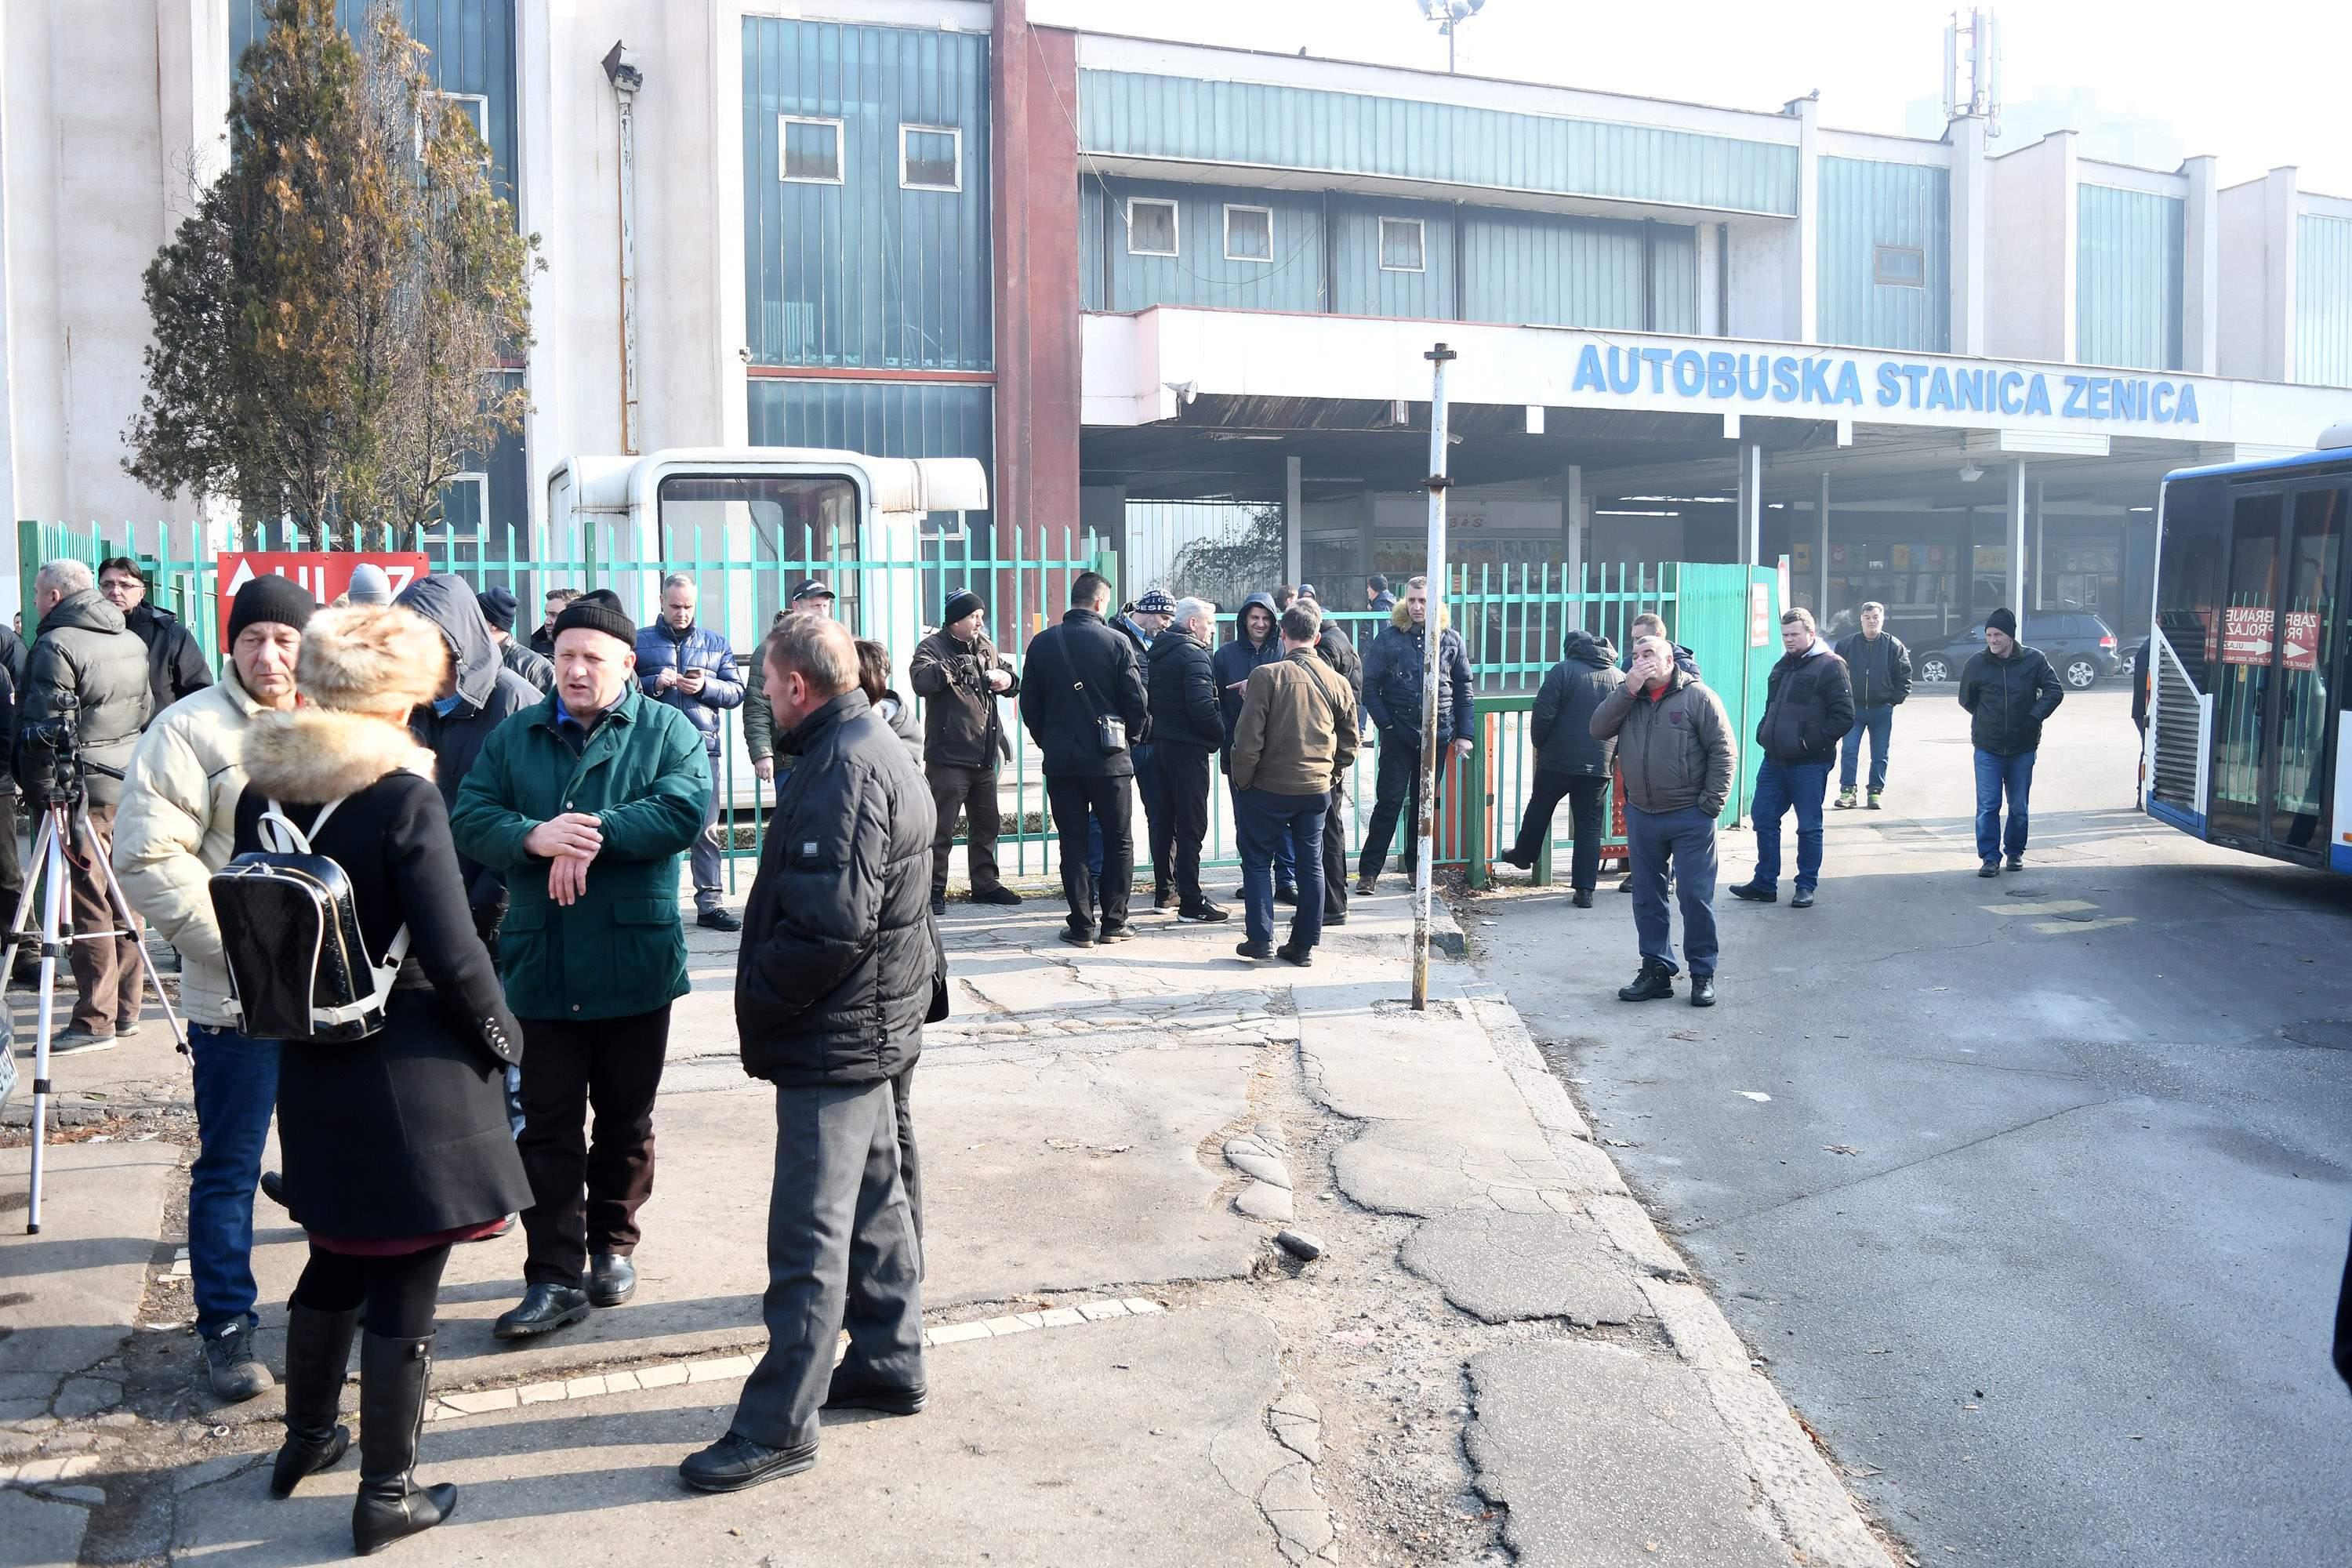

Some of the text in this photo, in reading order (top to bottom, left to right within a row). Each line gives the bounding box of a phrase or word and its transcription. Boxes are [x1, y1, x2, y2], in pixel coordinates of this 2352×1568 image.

[1572, 343, 2200, 424] AUTOBUSKA STANICA ZENICA
[56, 808, 64, 834] Canon
